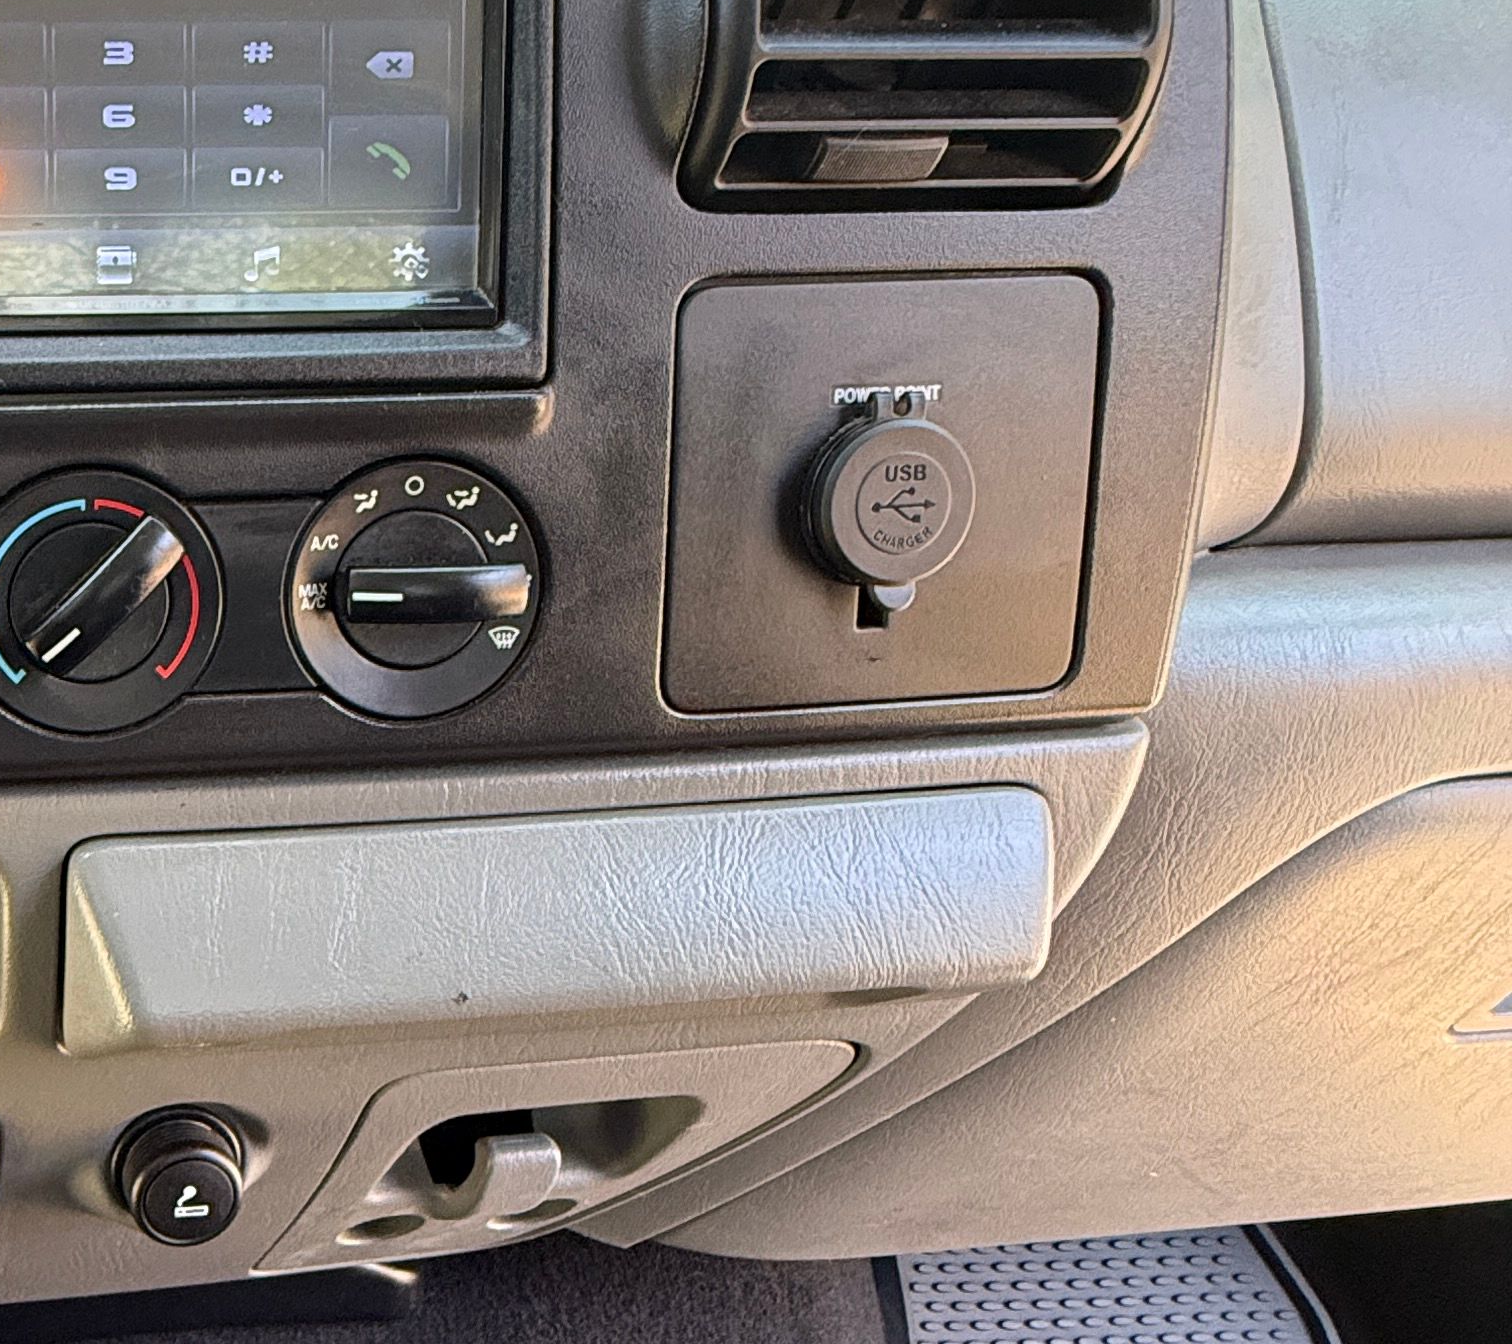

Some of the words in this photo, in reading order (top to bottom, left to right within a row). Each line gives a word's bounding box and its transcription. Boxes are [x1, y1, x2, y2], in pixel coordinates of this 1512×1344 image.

[103, 41, 134, 65] 3
[243, 41, 274, 64] #
[103, 104, 135, 128] 6
[104, 167, 137, 190] 9
[230, 167, 284, 186] 0/+
[884, 464, 928, 482] USB
[310, 534, 339, 552] A/C
[873, 526, 934, 551] CHARGER
[298, 582, 328, 599] MAX
[300, 596, 326, 611] A/C
